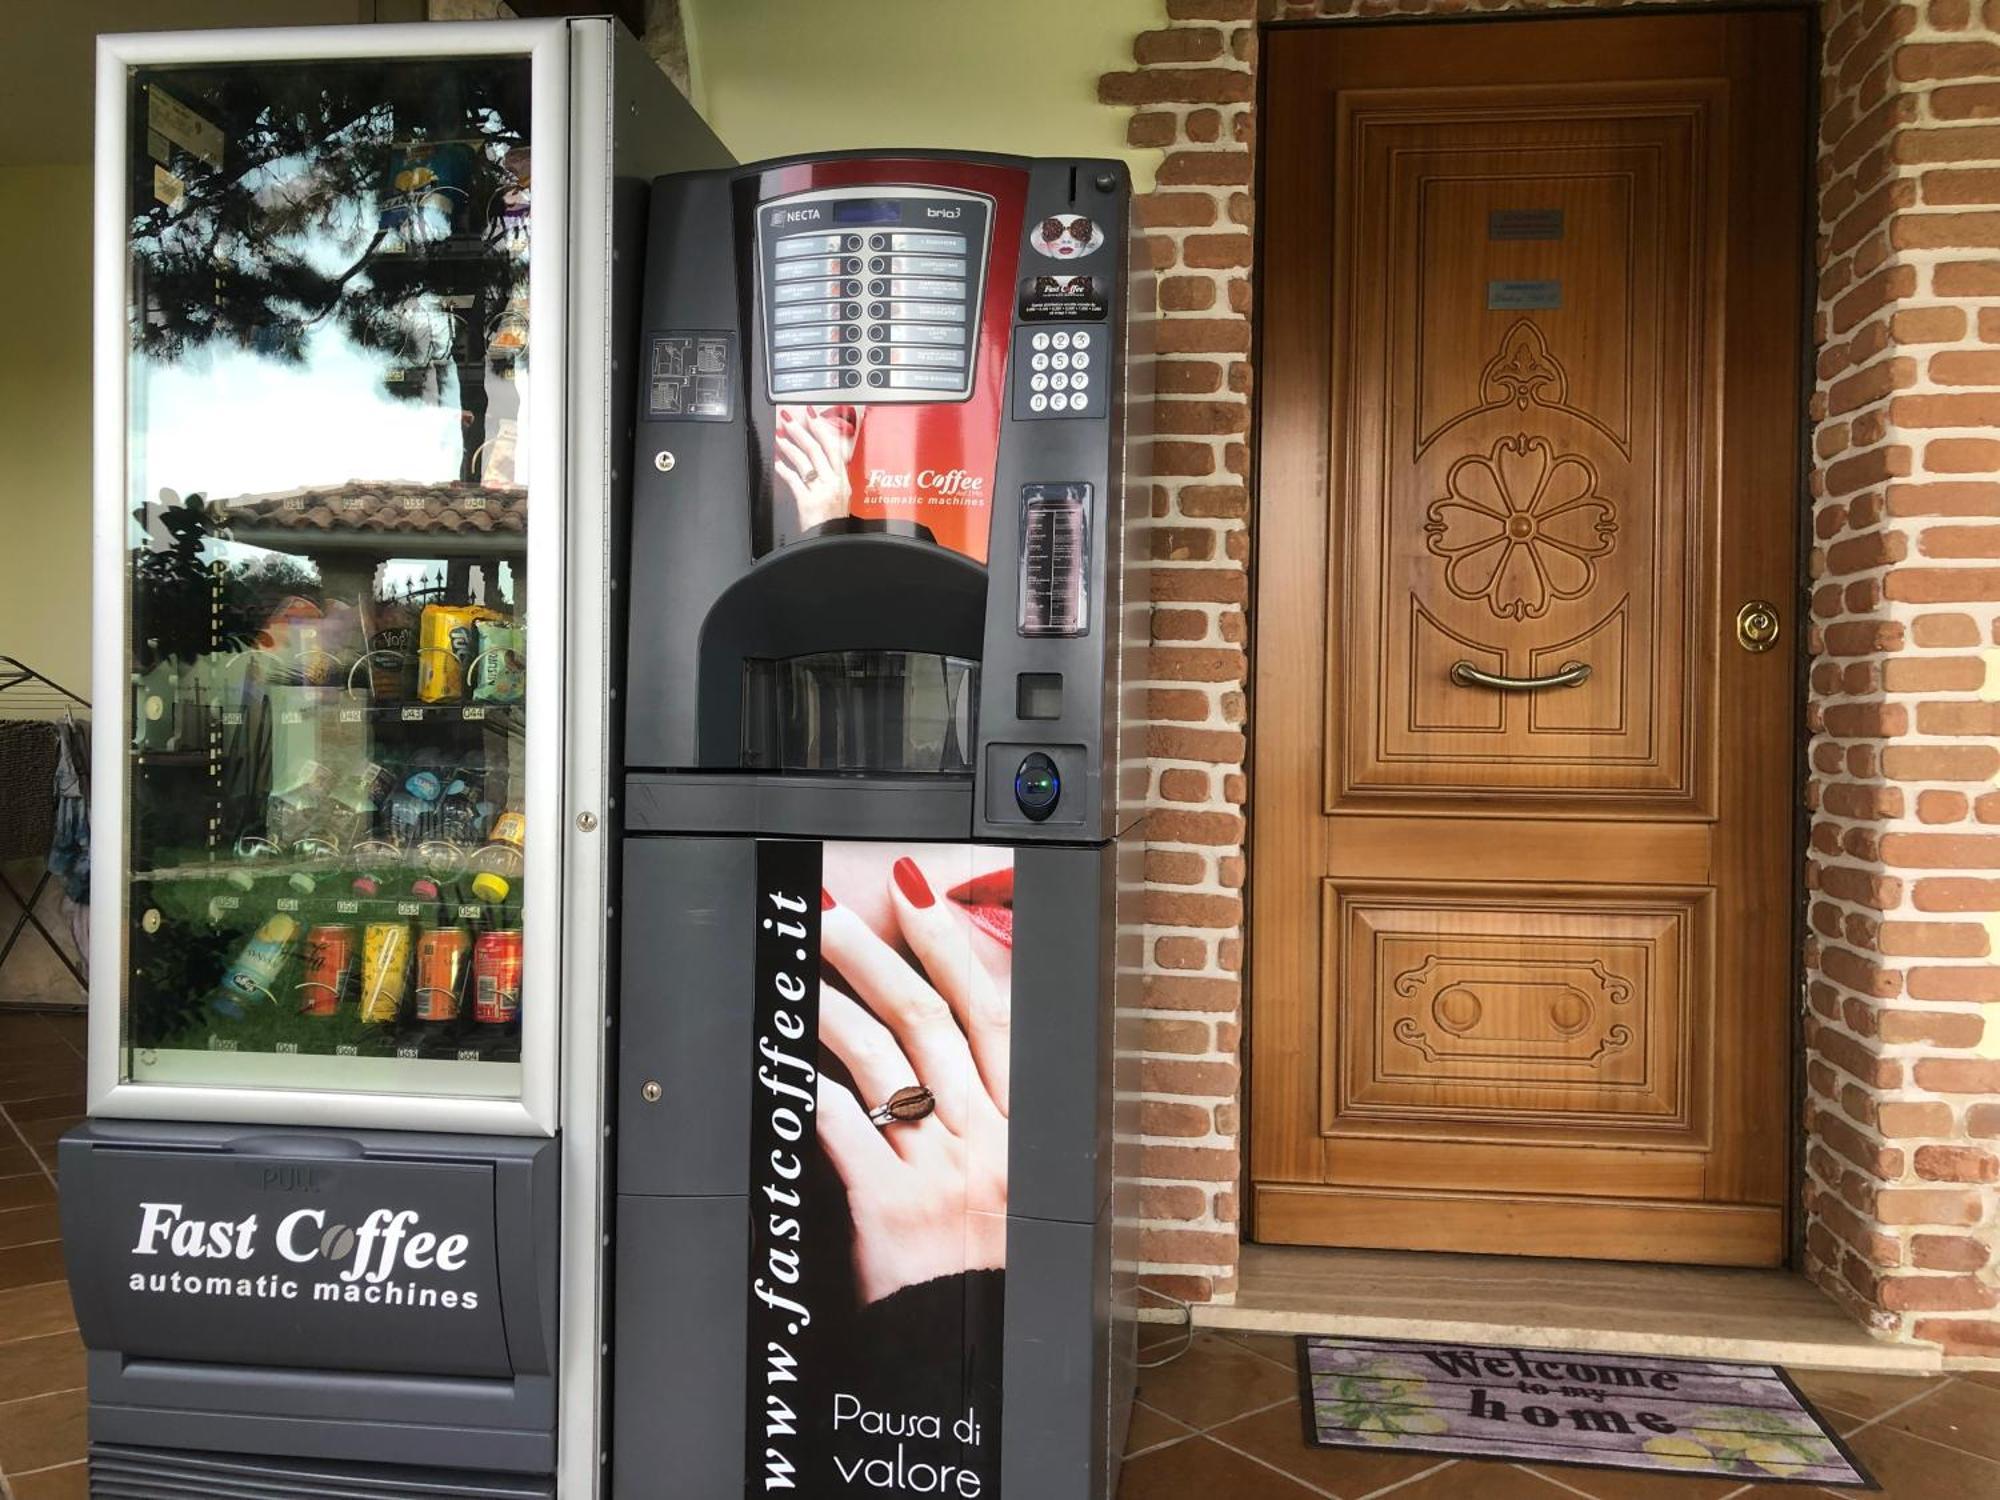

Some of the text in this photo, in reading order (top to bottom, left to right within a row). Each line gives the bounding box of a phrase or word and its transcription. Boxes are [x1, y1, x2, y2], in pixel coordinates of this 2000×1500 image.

[787, 209, 820, 222] NECTA
[864, 495, 985, 506] automatic machines
[867, 469, 983, 495] Fast Coffee
[754, 891, 818, 1492] www.fastcoffee.it
[132, 1202, 469, 1283] Fast Coffee
[129, 1270, 479, 1310] automatic machines
[1421, 1349, 1680, 1392] Welcome
[1517, 1379, 1608, 1403] to my
[834, 1393, 981, 1446] Pausa di
[1468, 1389, 1678, 1434] home
[833, 1442, 982, 1498] valore
